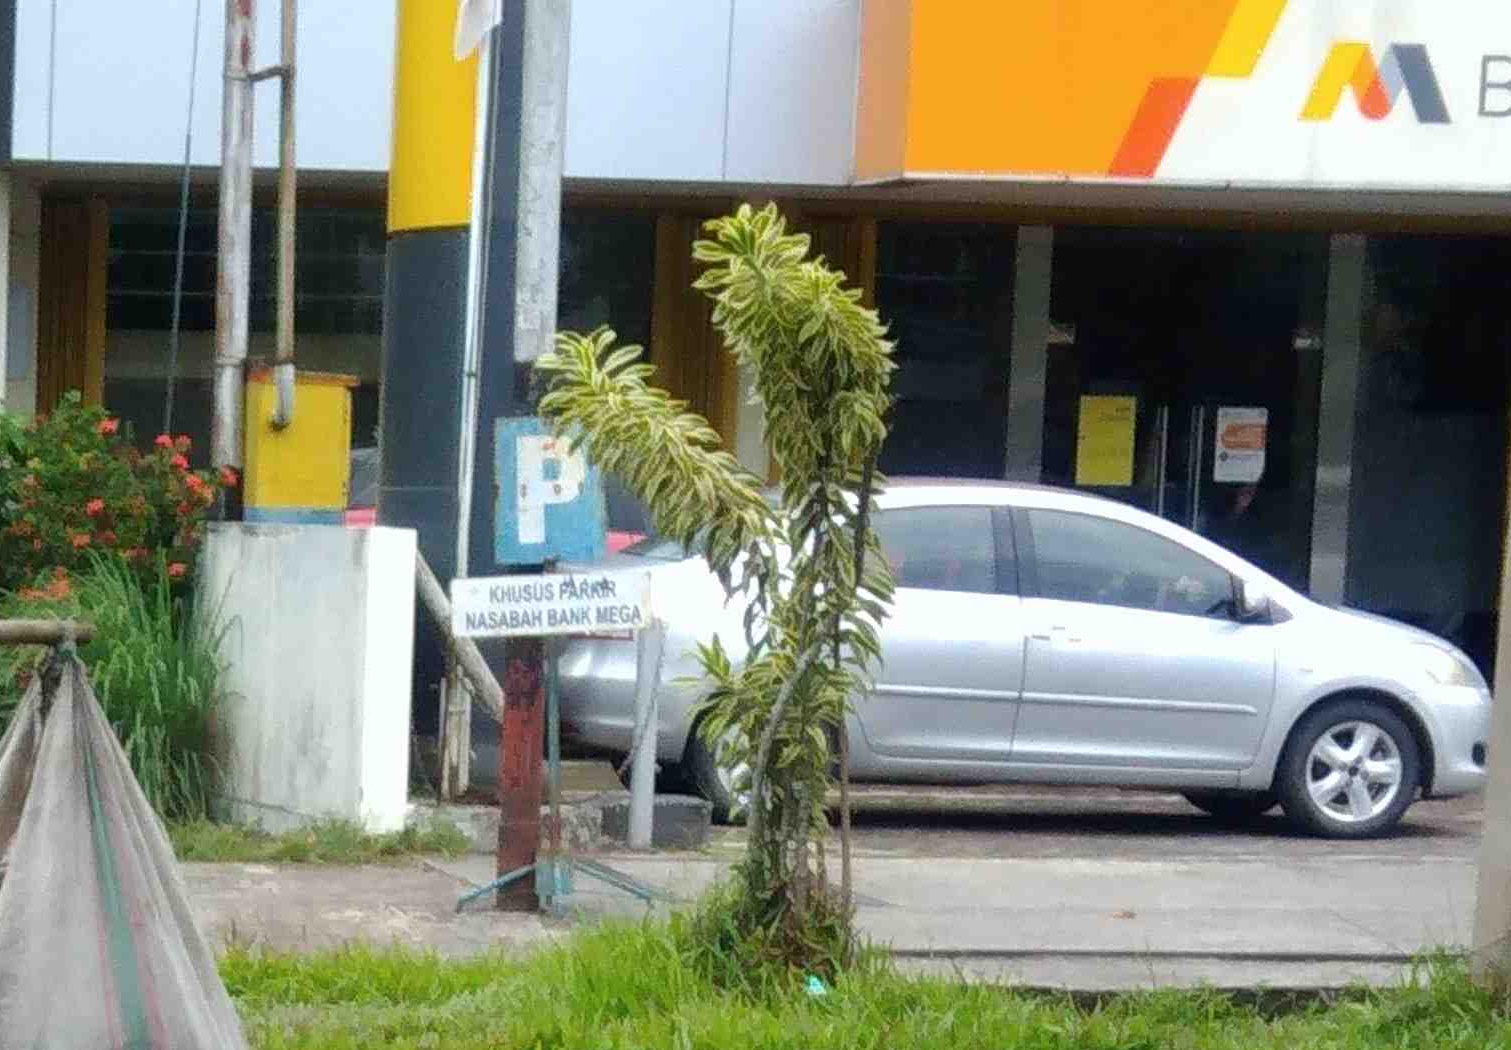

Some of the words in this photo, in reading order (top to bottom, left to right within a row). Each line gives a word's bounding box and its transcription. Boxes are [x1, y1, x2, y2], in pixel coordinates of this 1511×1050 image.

[517, 436, 585, 544] P
[489, 583, 554, 603] KHUSUS
[559, 578, 617, 600] PARKIR
[465, 609, 542, 631] NASABAH
[547, 606, 591, 627] BANK
[596, 604, 642, 625] MEGA
